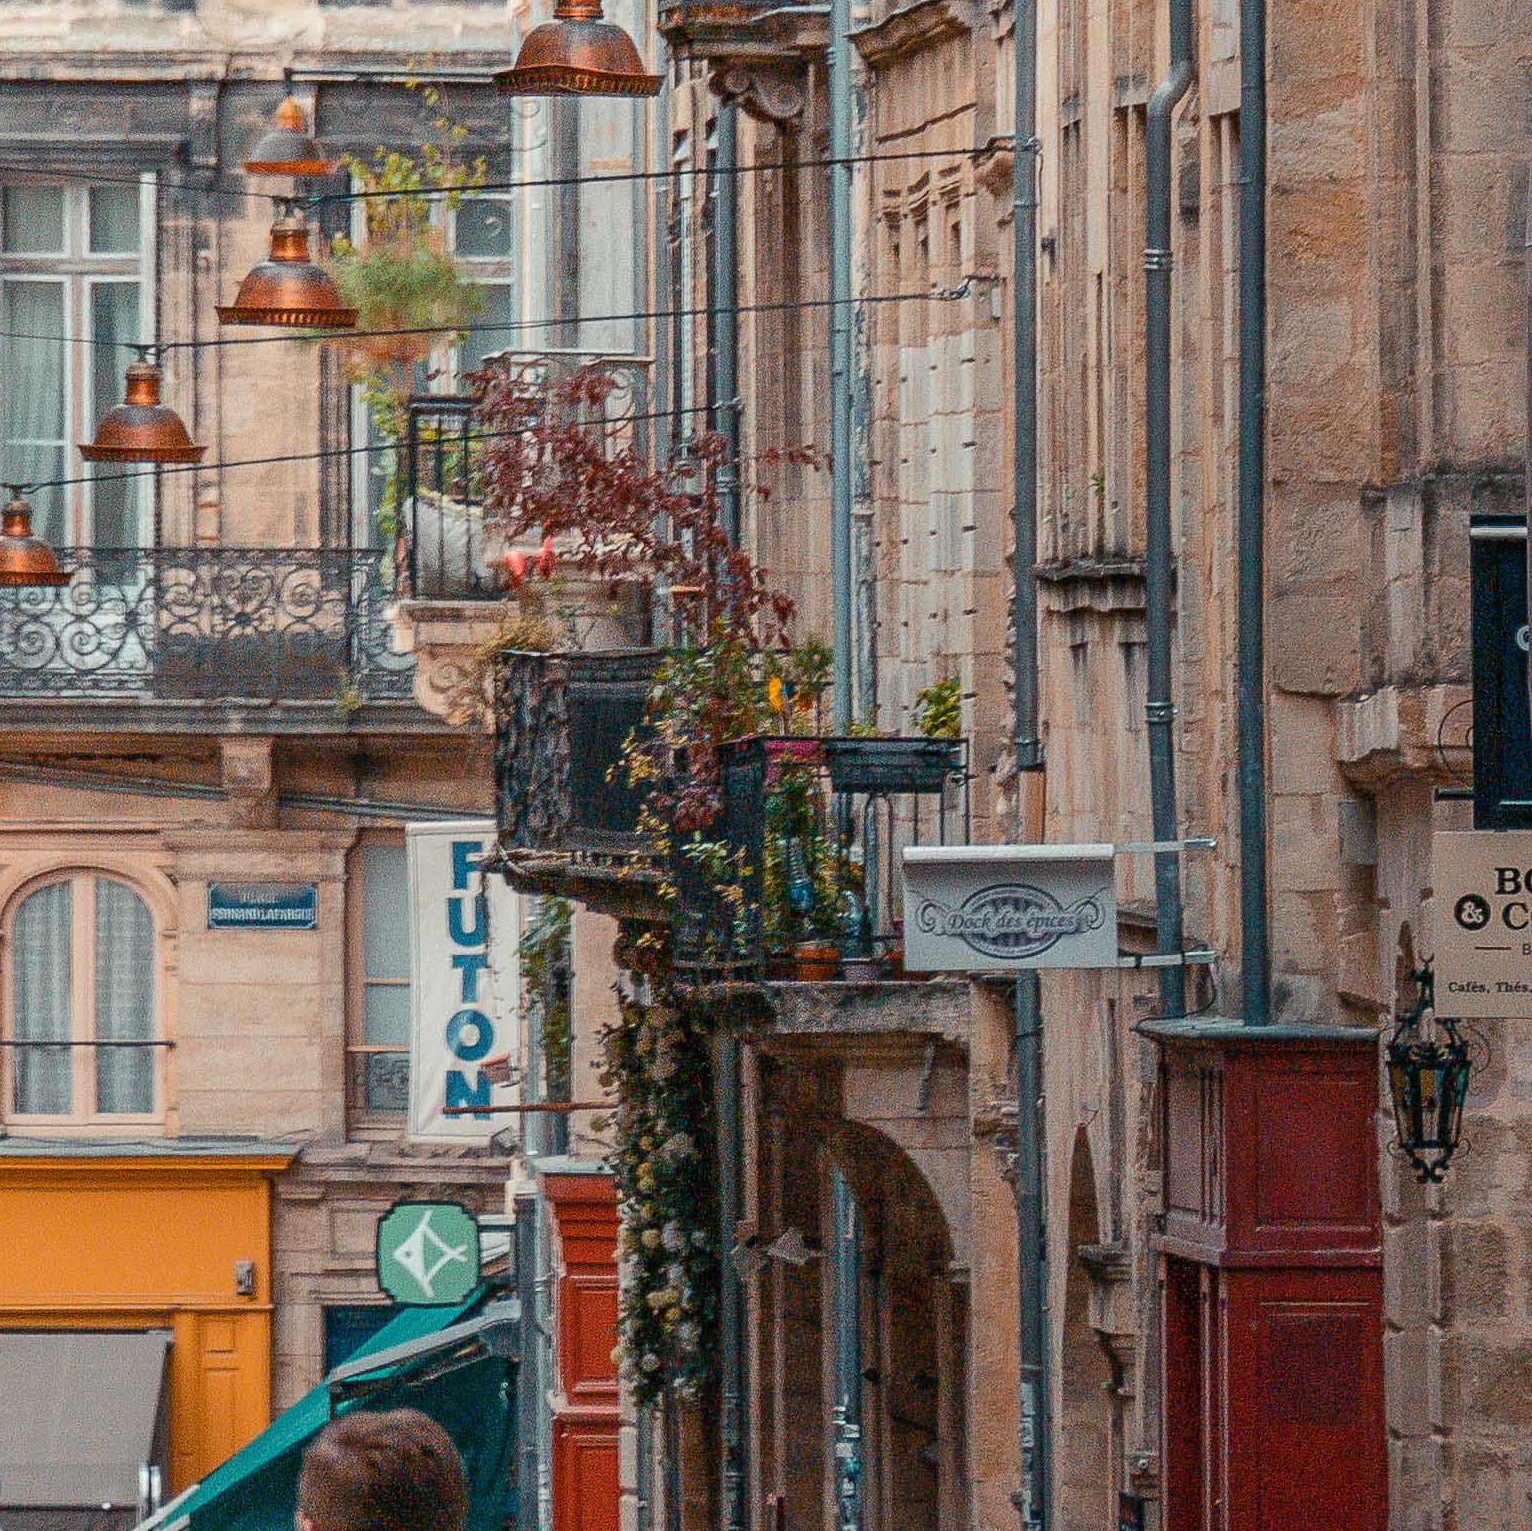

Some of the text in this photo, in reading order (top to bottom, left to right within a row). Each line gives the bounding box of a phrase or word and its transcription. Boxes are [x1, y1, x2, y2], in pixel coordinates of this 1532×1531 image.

[1494, 867, 1532, 895] B
[948, 911, 991, 929] Dock
[445, 841, 494, 1120] FUTON
